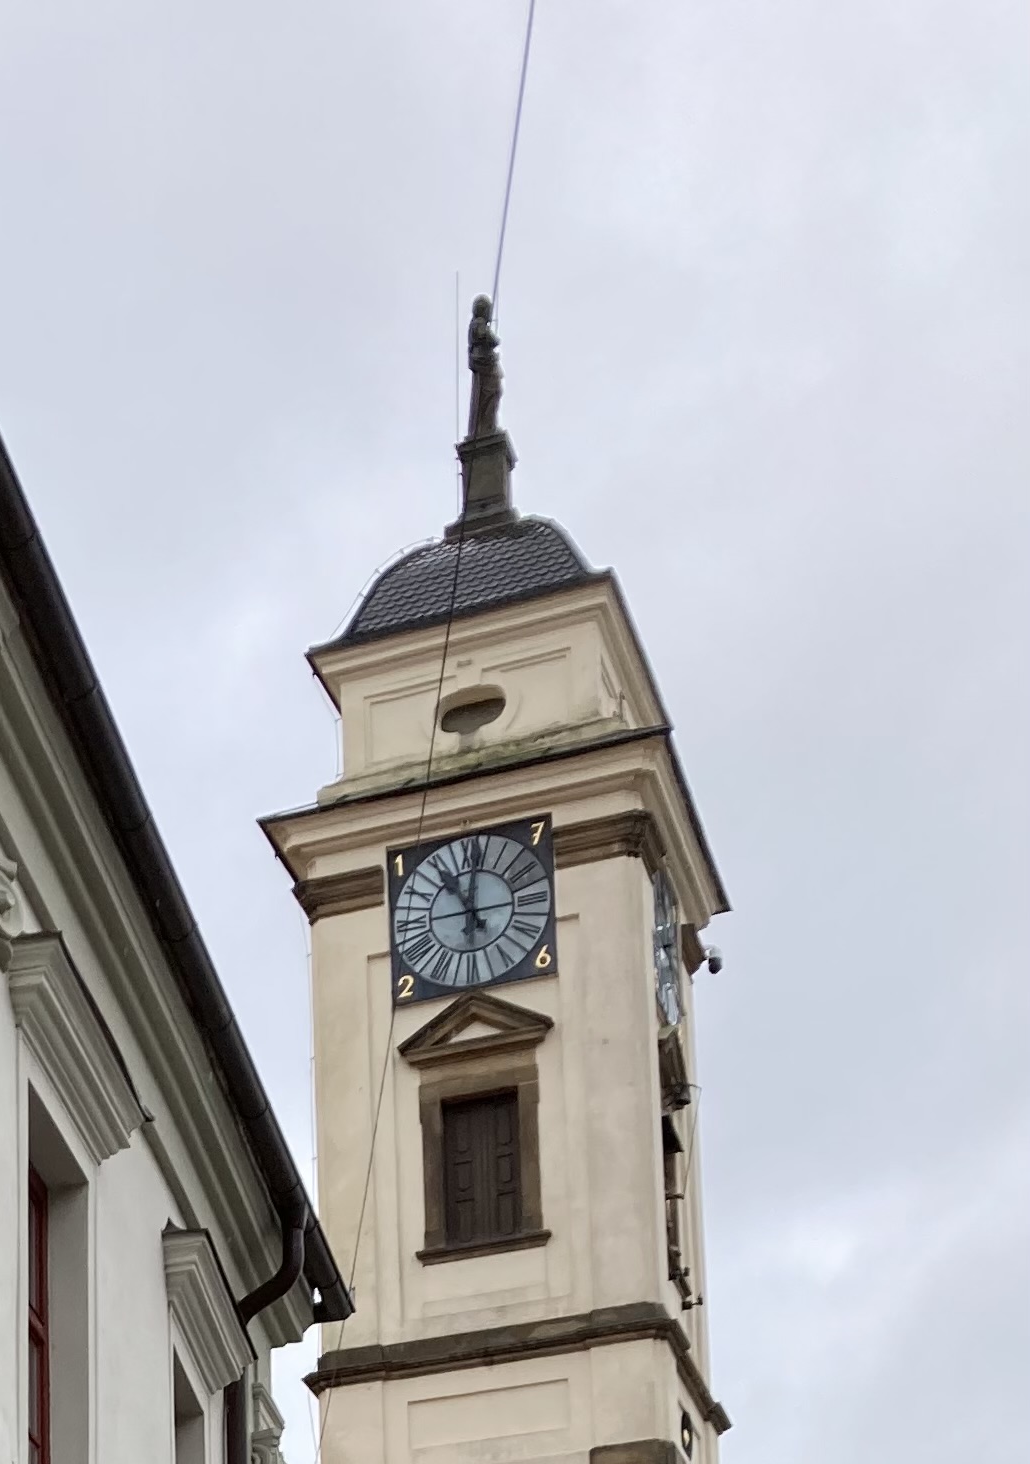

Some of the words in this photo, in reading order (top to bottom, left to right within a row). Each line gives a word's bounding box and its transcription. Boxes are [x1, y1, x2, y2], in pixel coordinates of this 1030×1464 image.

[530, 820, 545, 846] 7
[394, 853, 405, 877] 1
[534, 944, 552, 969] 6
[397, 974, 415, 998] 2
